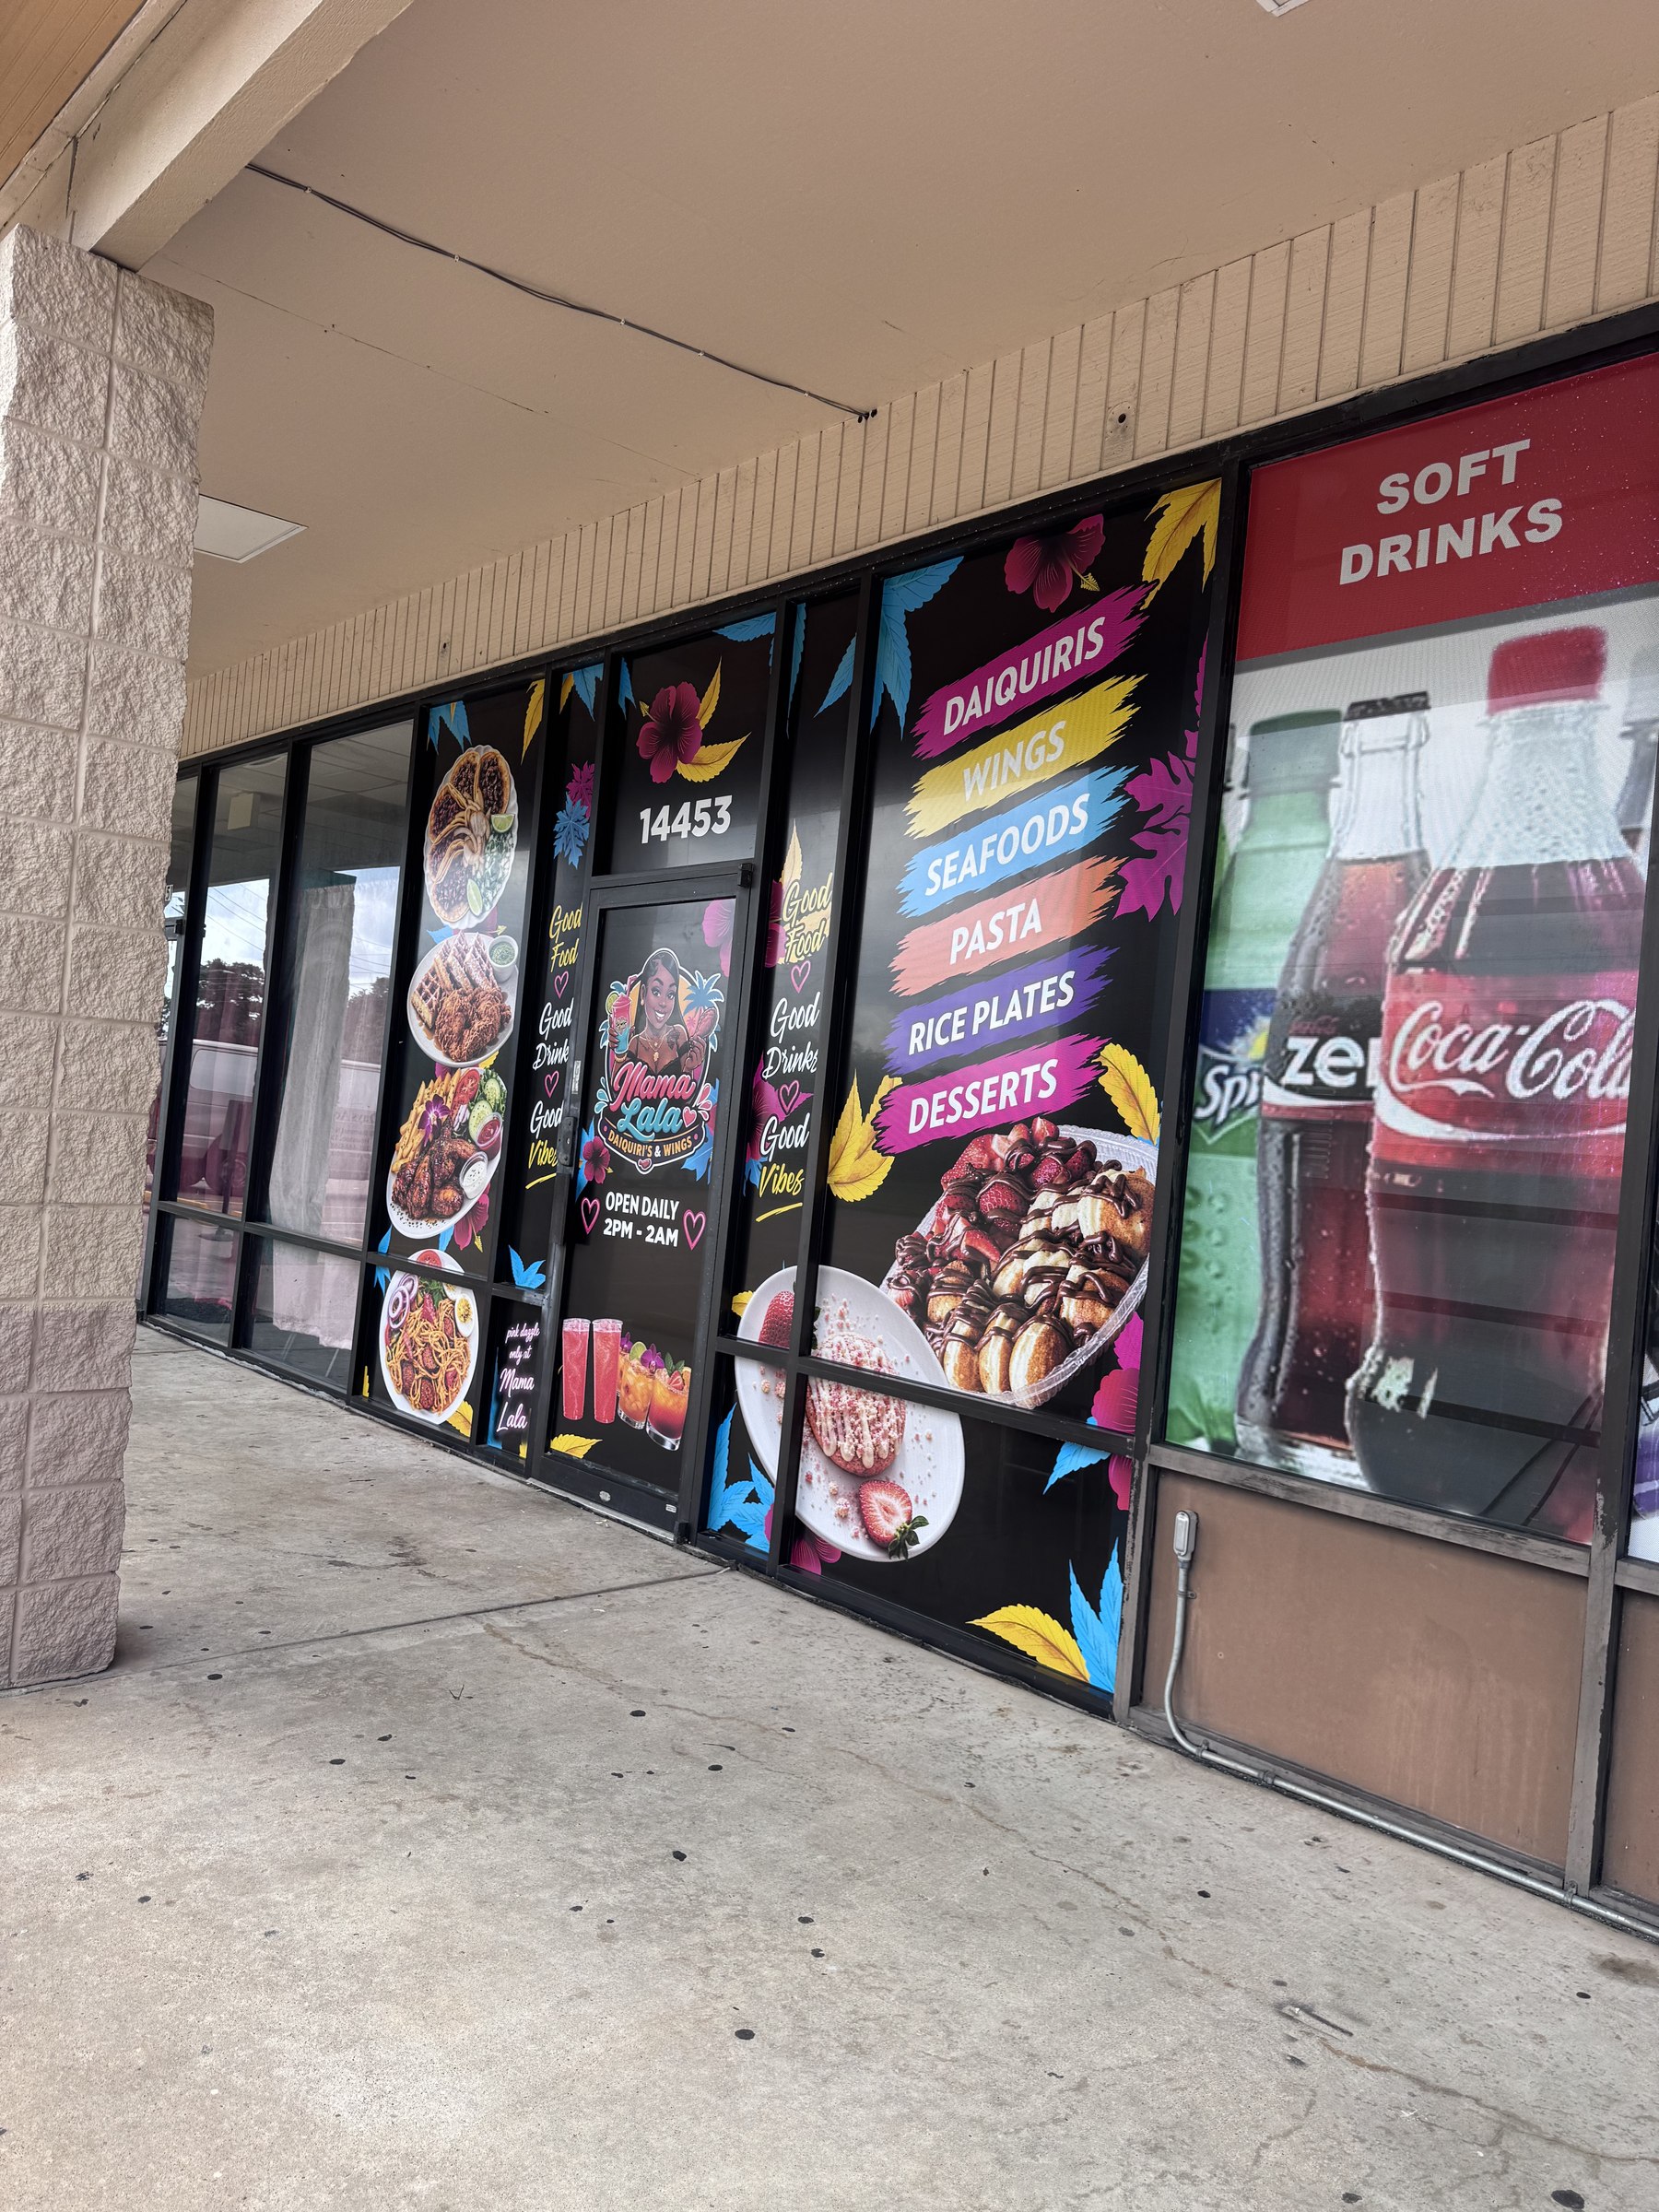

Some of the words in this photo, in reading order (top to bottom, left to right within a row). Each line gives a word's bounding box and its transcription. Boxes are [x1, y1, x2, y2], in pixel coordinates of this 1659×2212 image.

[1376, 439, 1531, 514] SOFT
[1339, 498, 1563, 585] DRINKS
[943, 617, 1106, 735] DAIQUIRIS
[962, 721, 1065, 802] WINGS
[640, 794, 733, 844] 14453
[924, 794, 1090, 896] SEAFOODS
[782, 872, 832, 927] Good
[548, 902, 583, 944] Good
[785, 920, 826, 962] Food
[948, 899, 1042, 965] PASTA
[550, 938, 580, 972] Food
[538, 997, 574, 1041] Good
[770, 992, 820, 1043] Good
[908, 1007, 966, 1055] RICE
[971, 971, 1076, 1035] PLATES
[609, 1061, 696, 1112] Mama
[908, 1059, 1058, 1134] DESSERTS
[530, 1100, 565, 1139] Good
[617, 1098, 683, 1142] Lala
[759, 1112, 810, 1162] Good
[607, 1129, 653, 1158] DAIQUIRI'S
[654, 1145, 662, 1158] &
[663, 1136, 692, 1157] WINGS
[759, 1162, 805, 1197] Vibes
[605, 1191, 640, 1216] OPEN
[641, 1196, 679, 1220] DAILY
[603, 1218, 633, 1240] 2PM
[644, 1225, 679, 1247] 2AM
[505, 1323, 520, 1344] pink
[520, 1322, 541, 1343] dazzle
[509, 1345, 523, 1365] only
[523, 1346, 532, 1359] at
[500, 1368, 535, 1397] Mama
[496, 1402, 528, 1432] Lala
